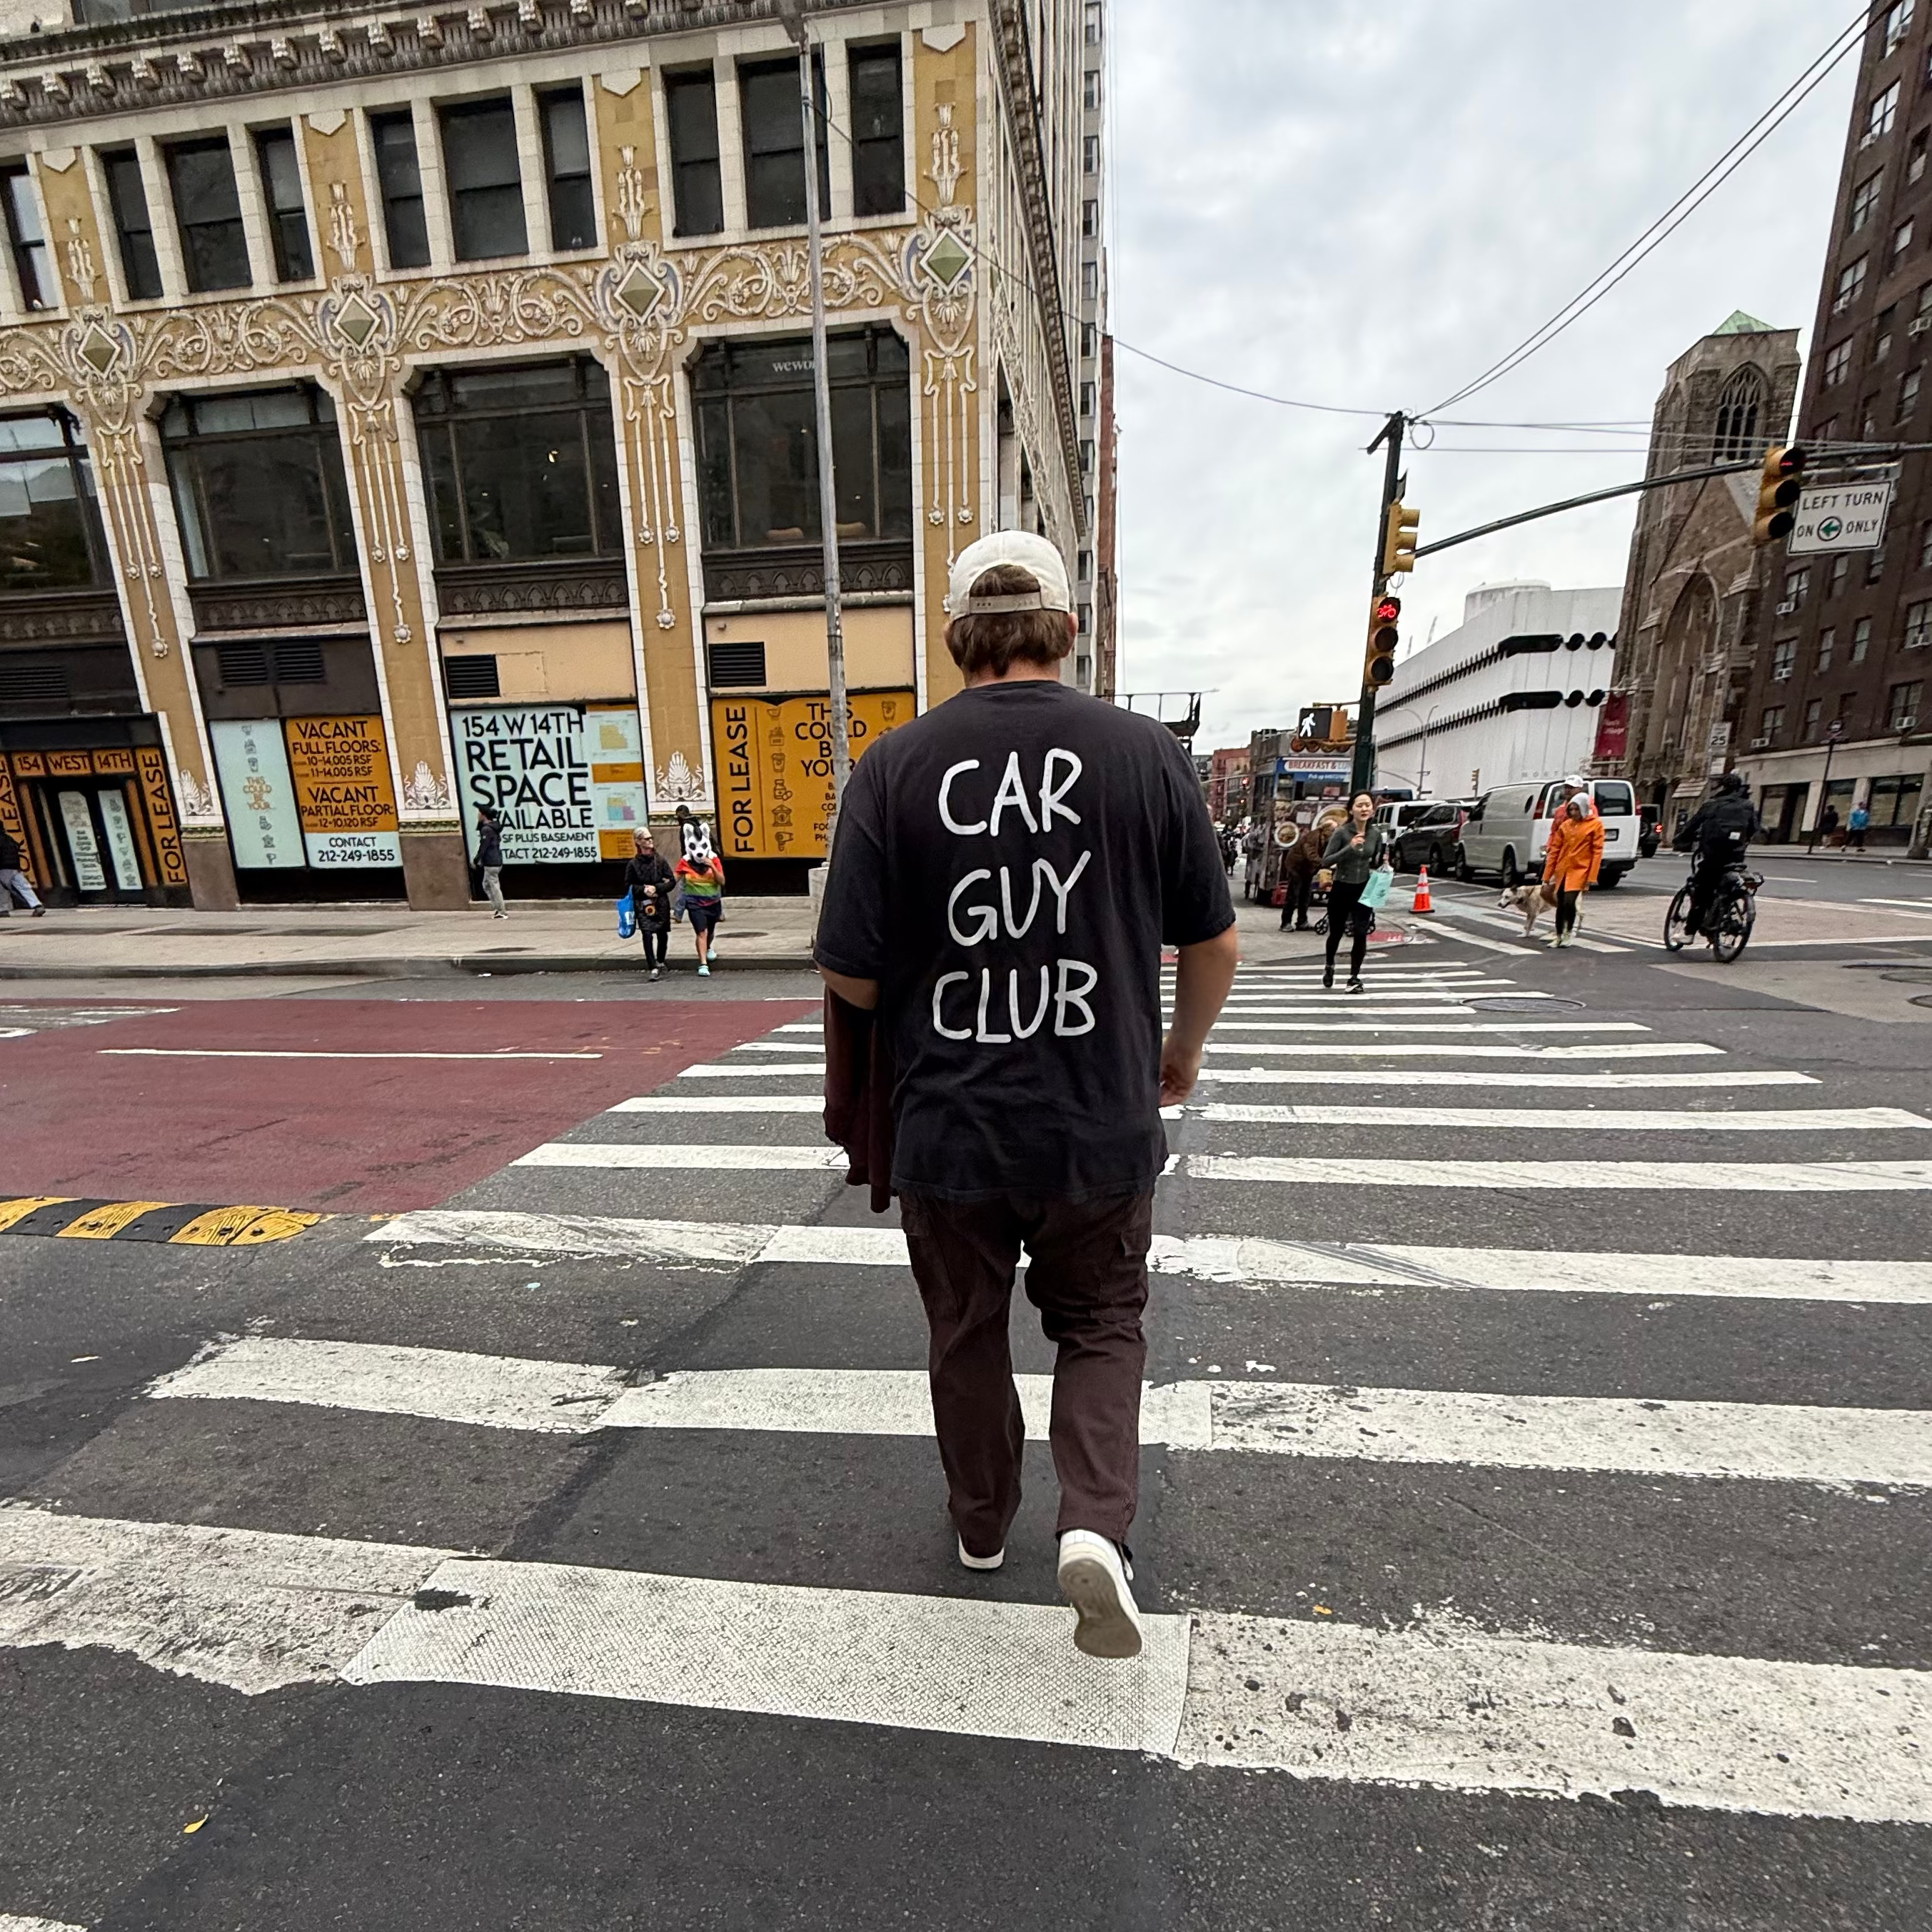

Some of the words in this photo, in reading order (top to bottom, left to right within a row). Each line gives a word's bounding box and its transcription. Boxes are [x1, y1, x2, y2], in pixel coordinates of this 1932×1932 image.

[773, 361, 815, 372] wewo
[1802, 495, 1840, 510] LEFT
[1845, 491, 1884, 507] TURN
[1796, 525, 1814, 538] ON
[1846, 519, 1879, 533] ONLY
[806, 701, 854, 720] THS
[296, 720, 368, 739] VACANT
[462, 715, 500, 738] 154
[503, 714, 525, 735] W
[530, 713, 584, 735] 14TH
[293, 741, 323, 755] FULL
[326, 739, 382, 753] FLOORS:
[726, 707, 750, 792] LEASE
[1711, 735, 1726, 745] 25
[18, 757, 41, 771] 154
[49, 755, 89, 770] WEST
[97, 753, 131, 768] 14TH
[353, 754, 372, 765] RSF
[465, 736, 588, 772] RETAIL
[354, 765, 373, 776] RSF
[142, 753, 173, 830] LEASE
[307, 785, 378, 804] VACANT
[470, 772, 591, 808] SPACE
[938, 748, 1082, 836] CAR
[301, 805, 348, 816] PARTIAL
[351, 804, 394, 816] FLOOR:
[476, 807, 594, 831] AILABLE
[360, 817, 378, 827] RSF
[733, 798, 755, 852] FOR
[328, 837, 376, 848] CONTACT
[502, 834, 513, 843] SF
[515, 832, 540, 842] PLUS
[541, 831, 595, 842] BASEMENT
[161, 834, 185, 883] FOR
[318, 849, 395, 862] 212-249-1855
[501, 848, 529, 859] TACT
[532, 845, 597, 859] 212-249-1855
[948, 850, 1092, 946] GUY
[932, 959, 1097, 1043] CLUB
